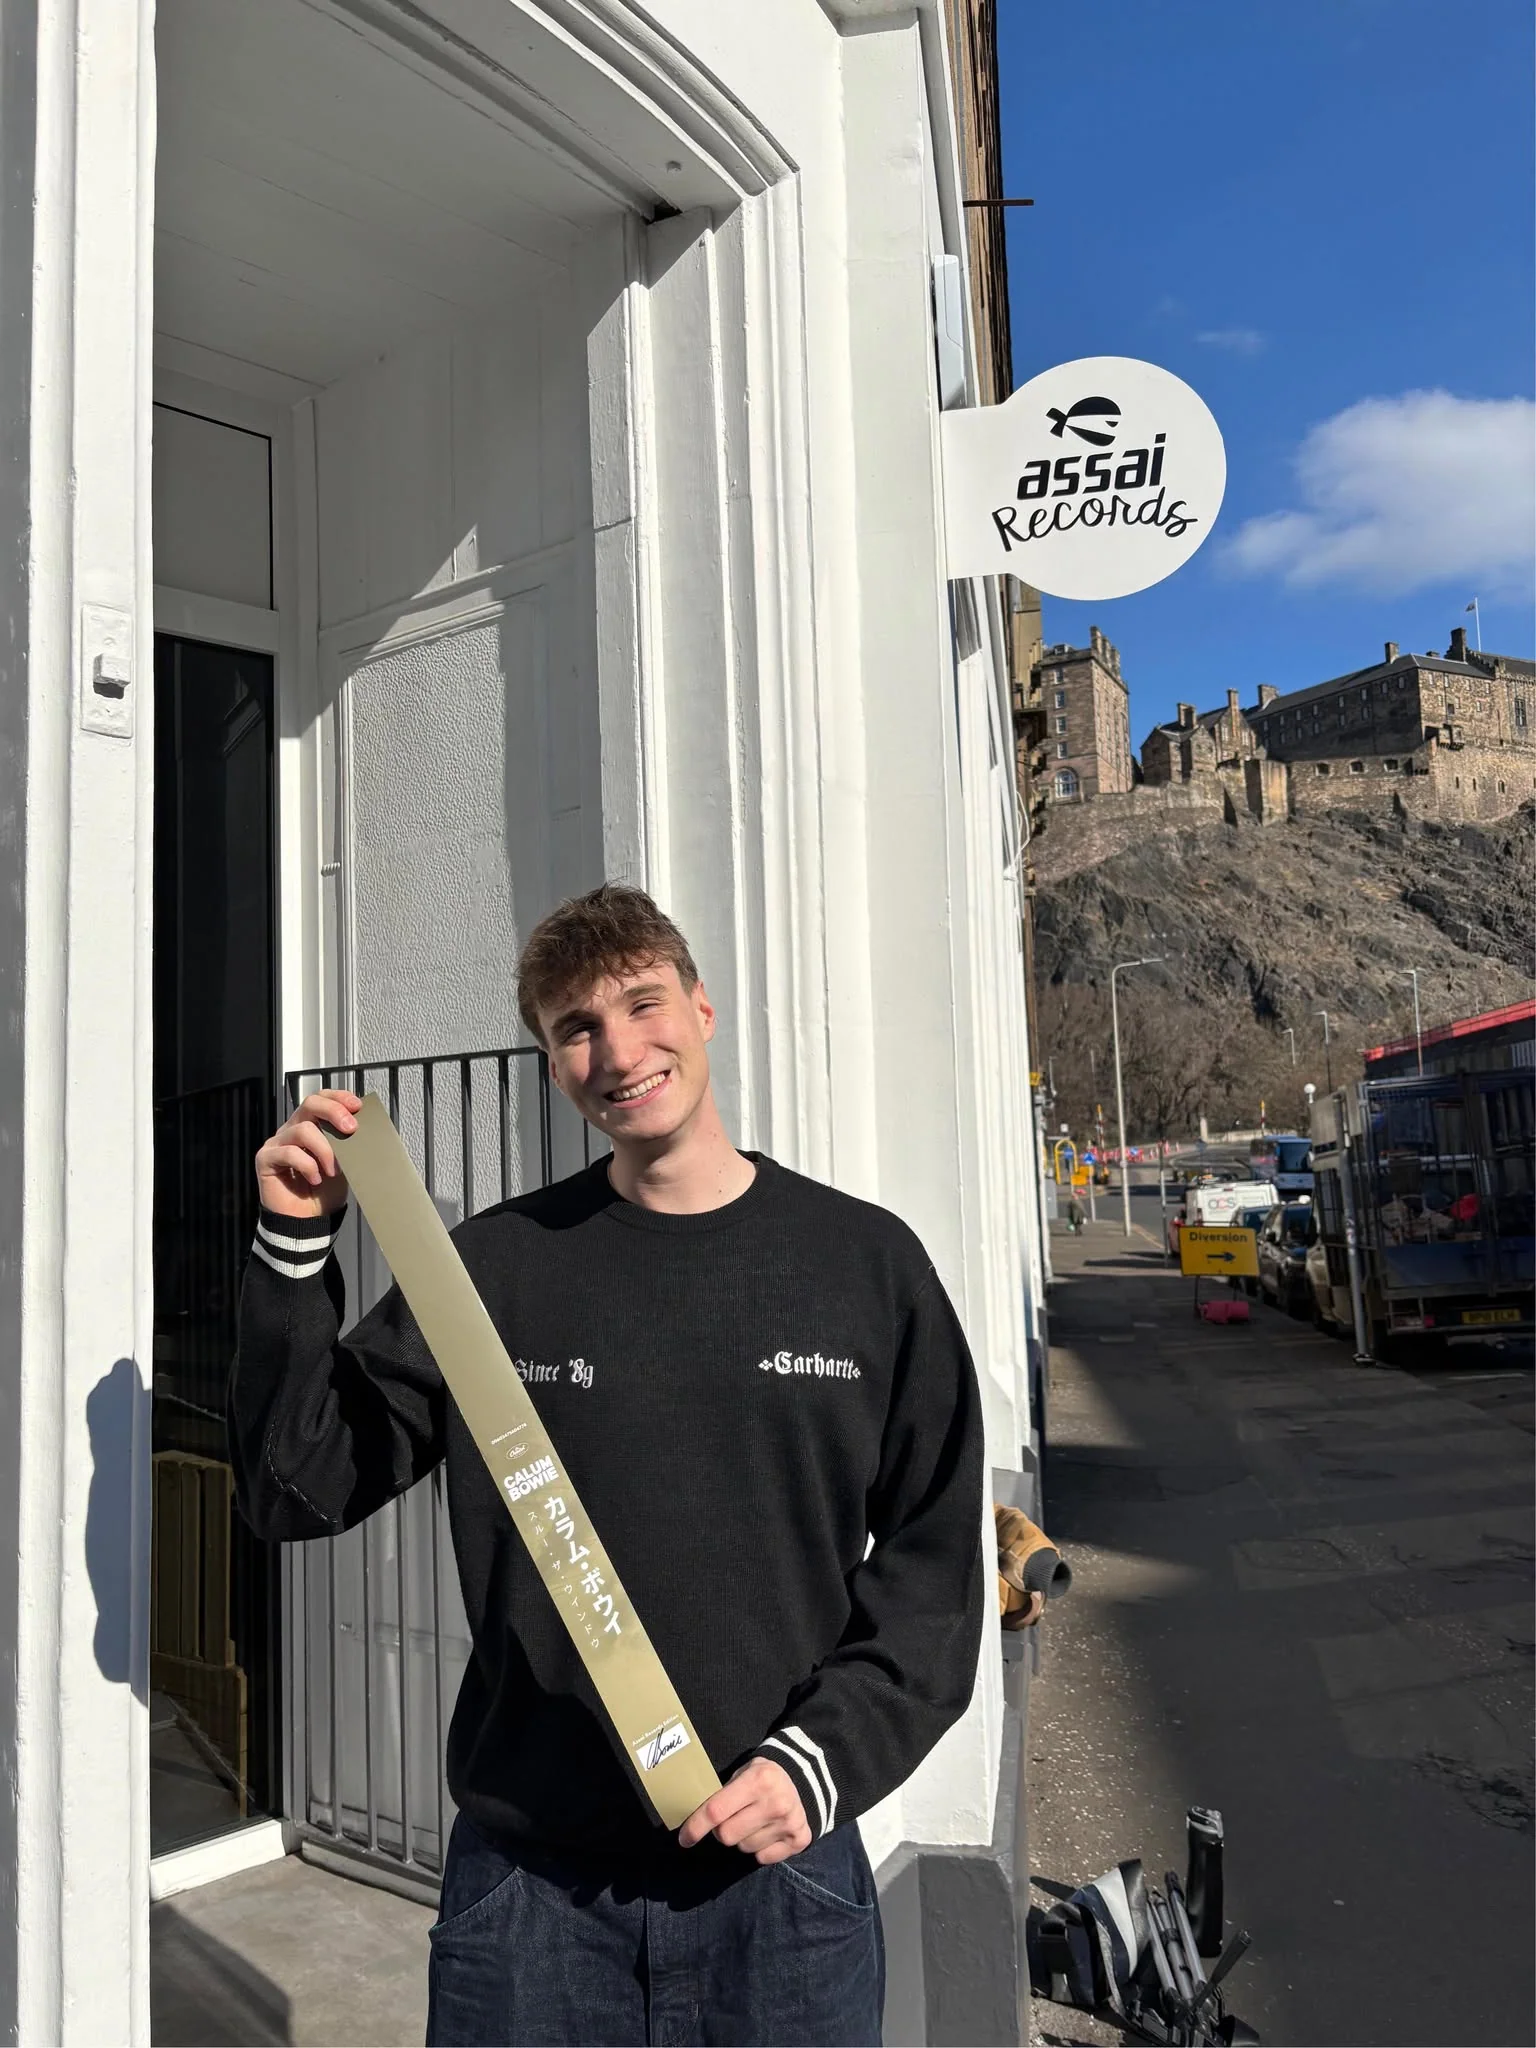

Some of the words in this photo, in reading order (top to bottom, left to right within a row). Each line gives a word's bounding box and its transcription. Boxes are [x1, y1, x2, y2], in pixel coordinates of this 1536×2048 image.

[1016, 432, 1167, 501] assai
[991, 486, 1199, 552] Records
[1189, 1231, 1249, 1243] Diversion
[515, 1358, 560, 1382] Since
[774, 1350, 855, 1381] Carhartt
[503, 1454, 554, 1490] CALUM
[508, 1466, 560, 1502] BOWIE
